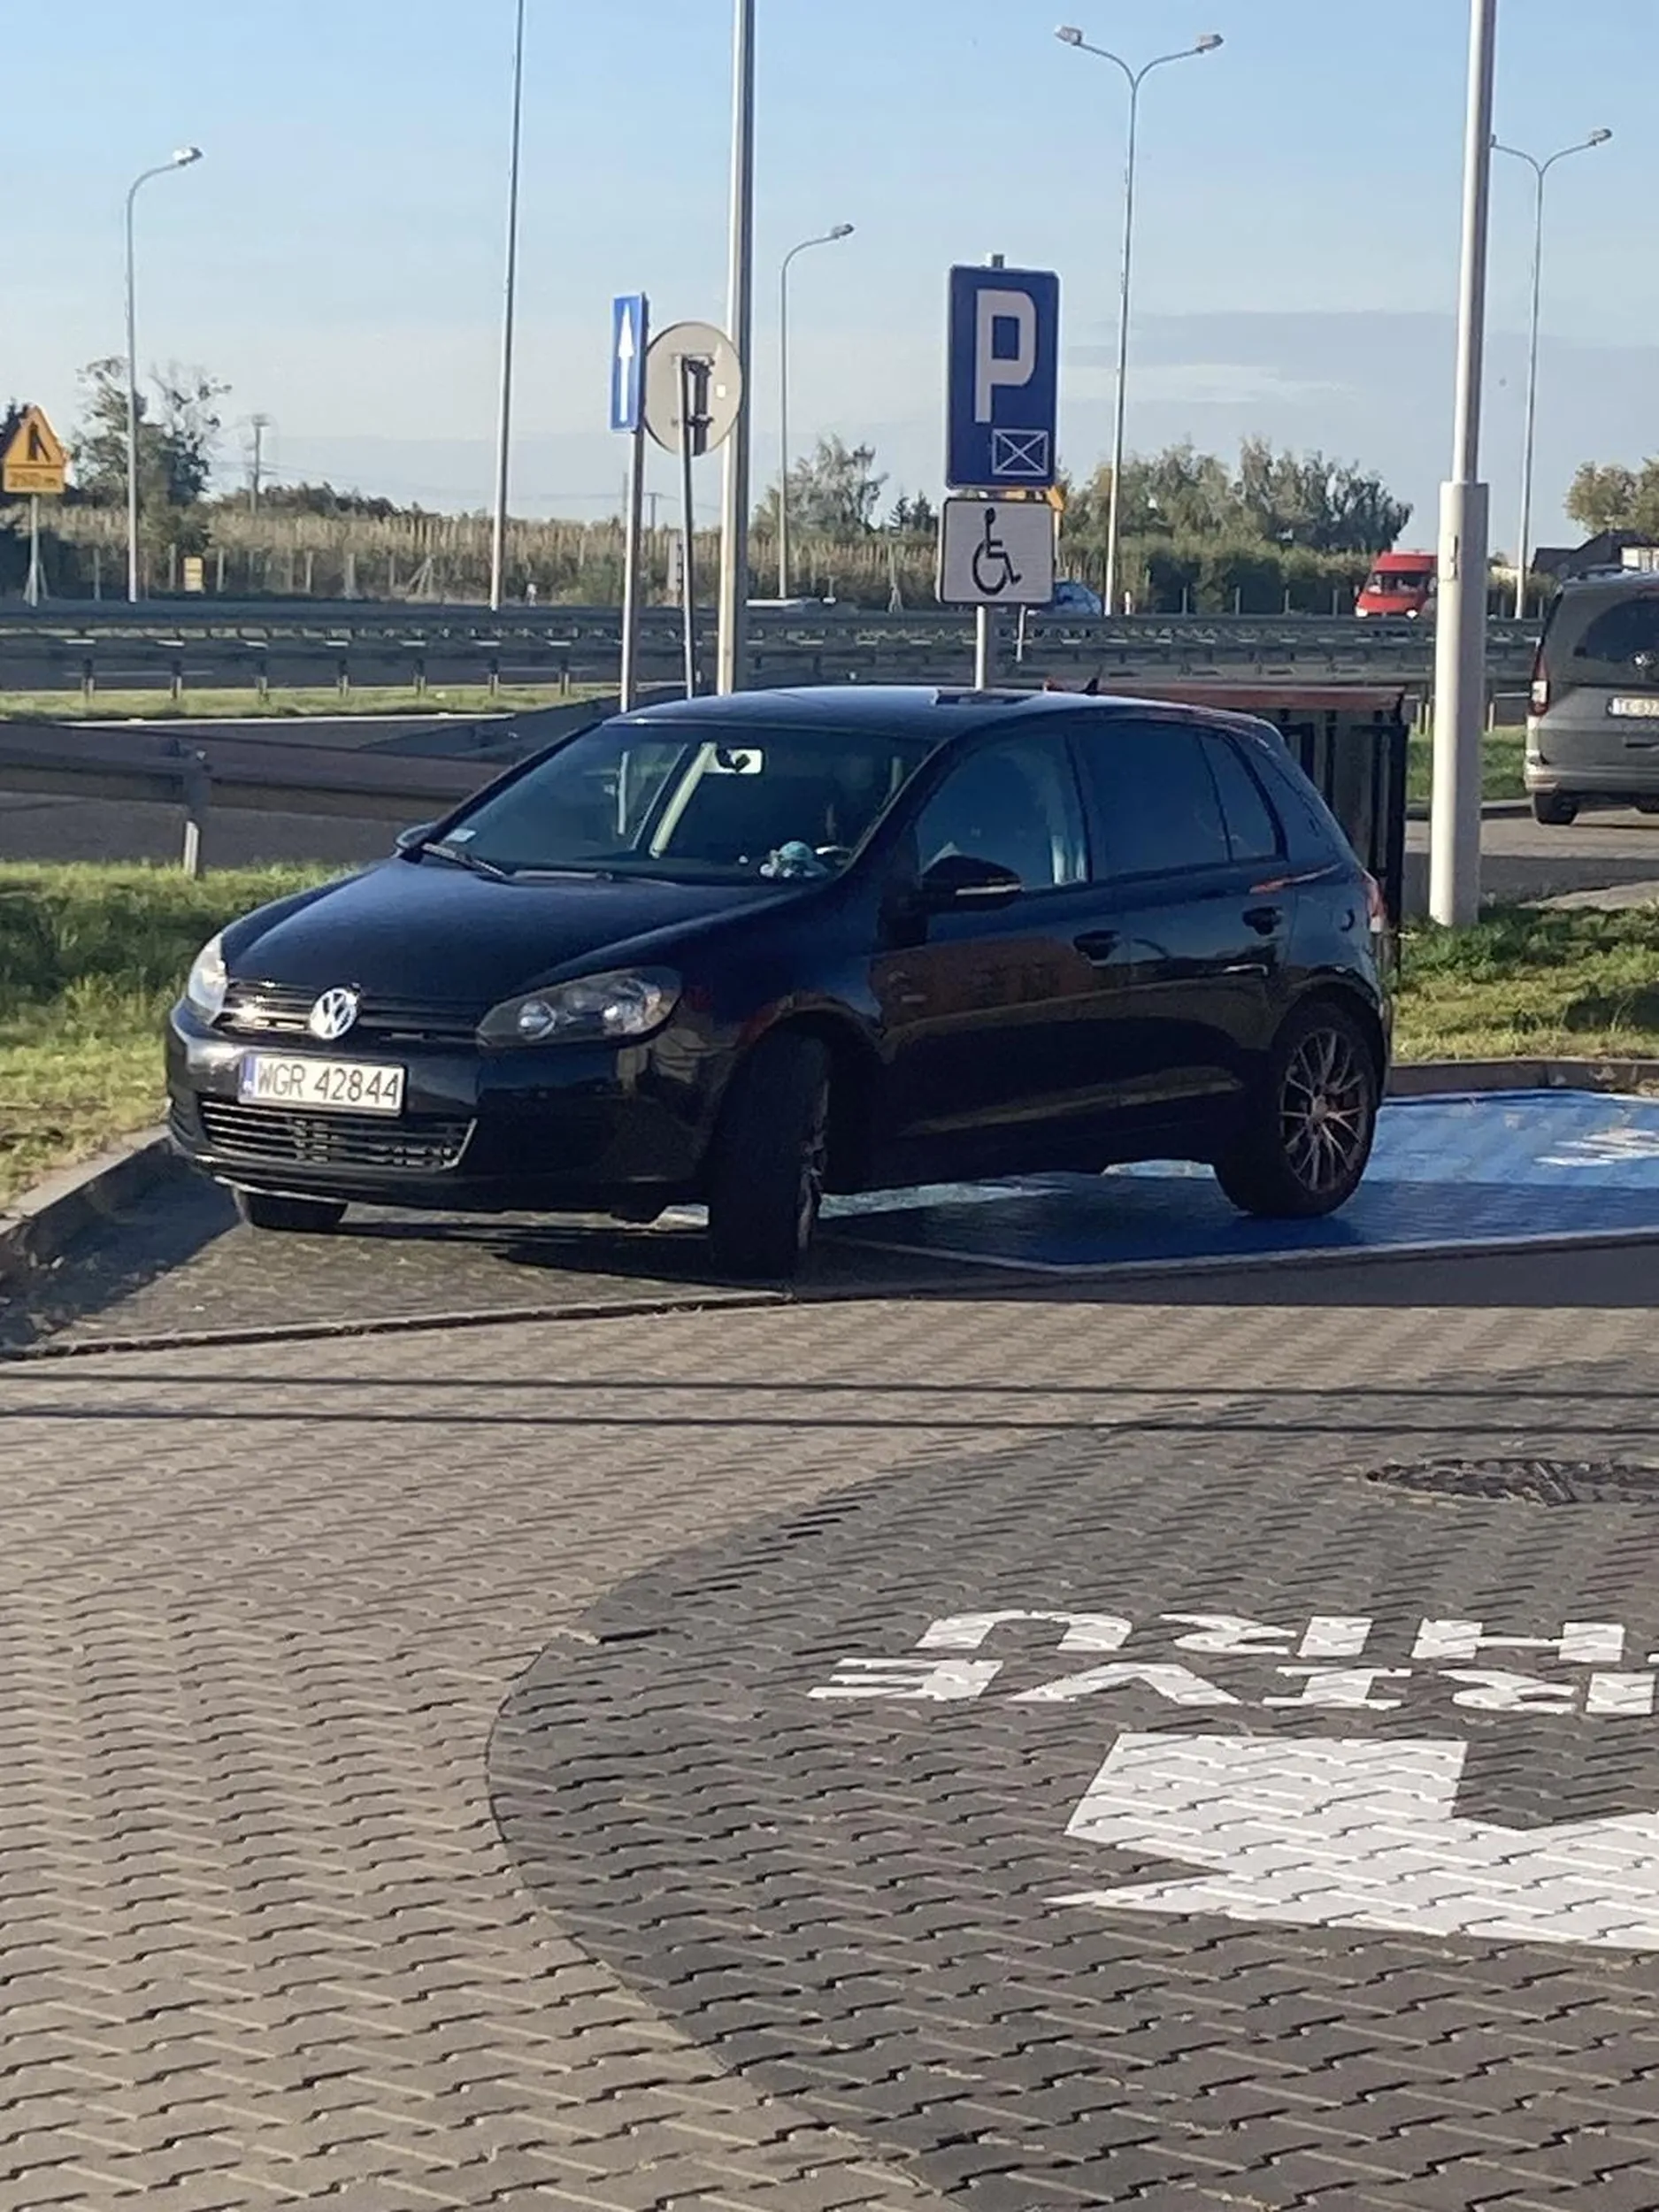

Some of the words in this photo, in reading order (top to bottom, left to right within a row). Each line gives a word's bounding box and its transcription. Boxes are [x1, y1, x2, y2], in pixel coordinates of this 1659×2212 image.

[974, 288, 1037, 423] P
[257, 1062, 306, 1098] WGR
[313, 1066, 399, 1106] 42844
[915, 1609, 1659, 1663] HRU
[806, 1656, 1656, 1715] RIVE
